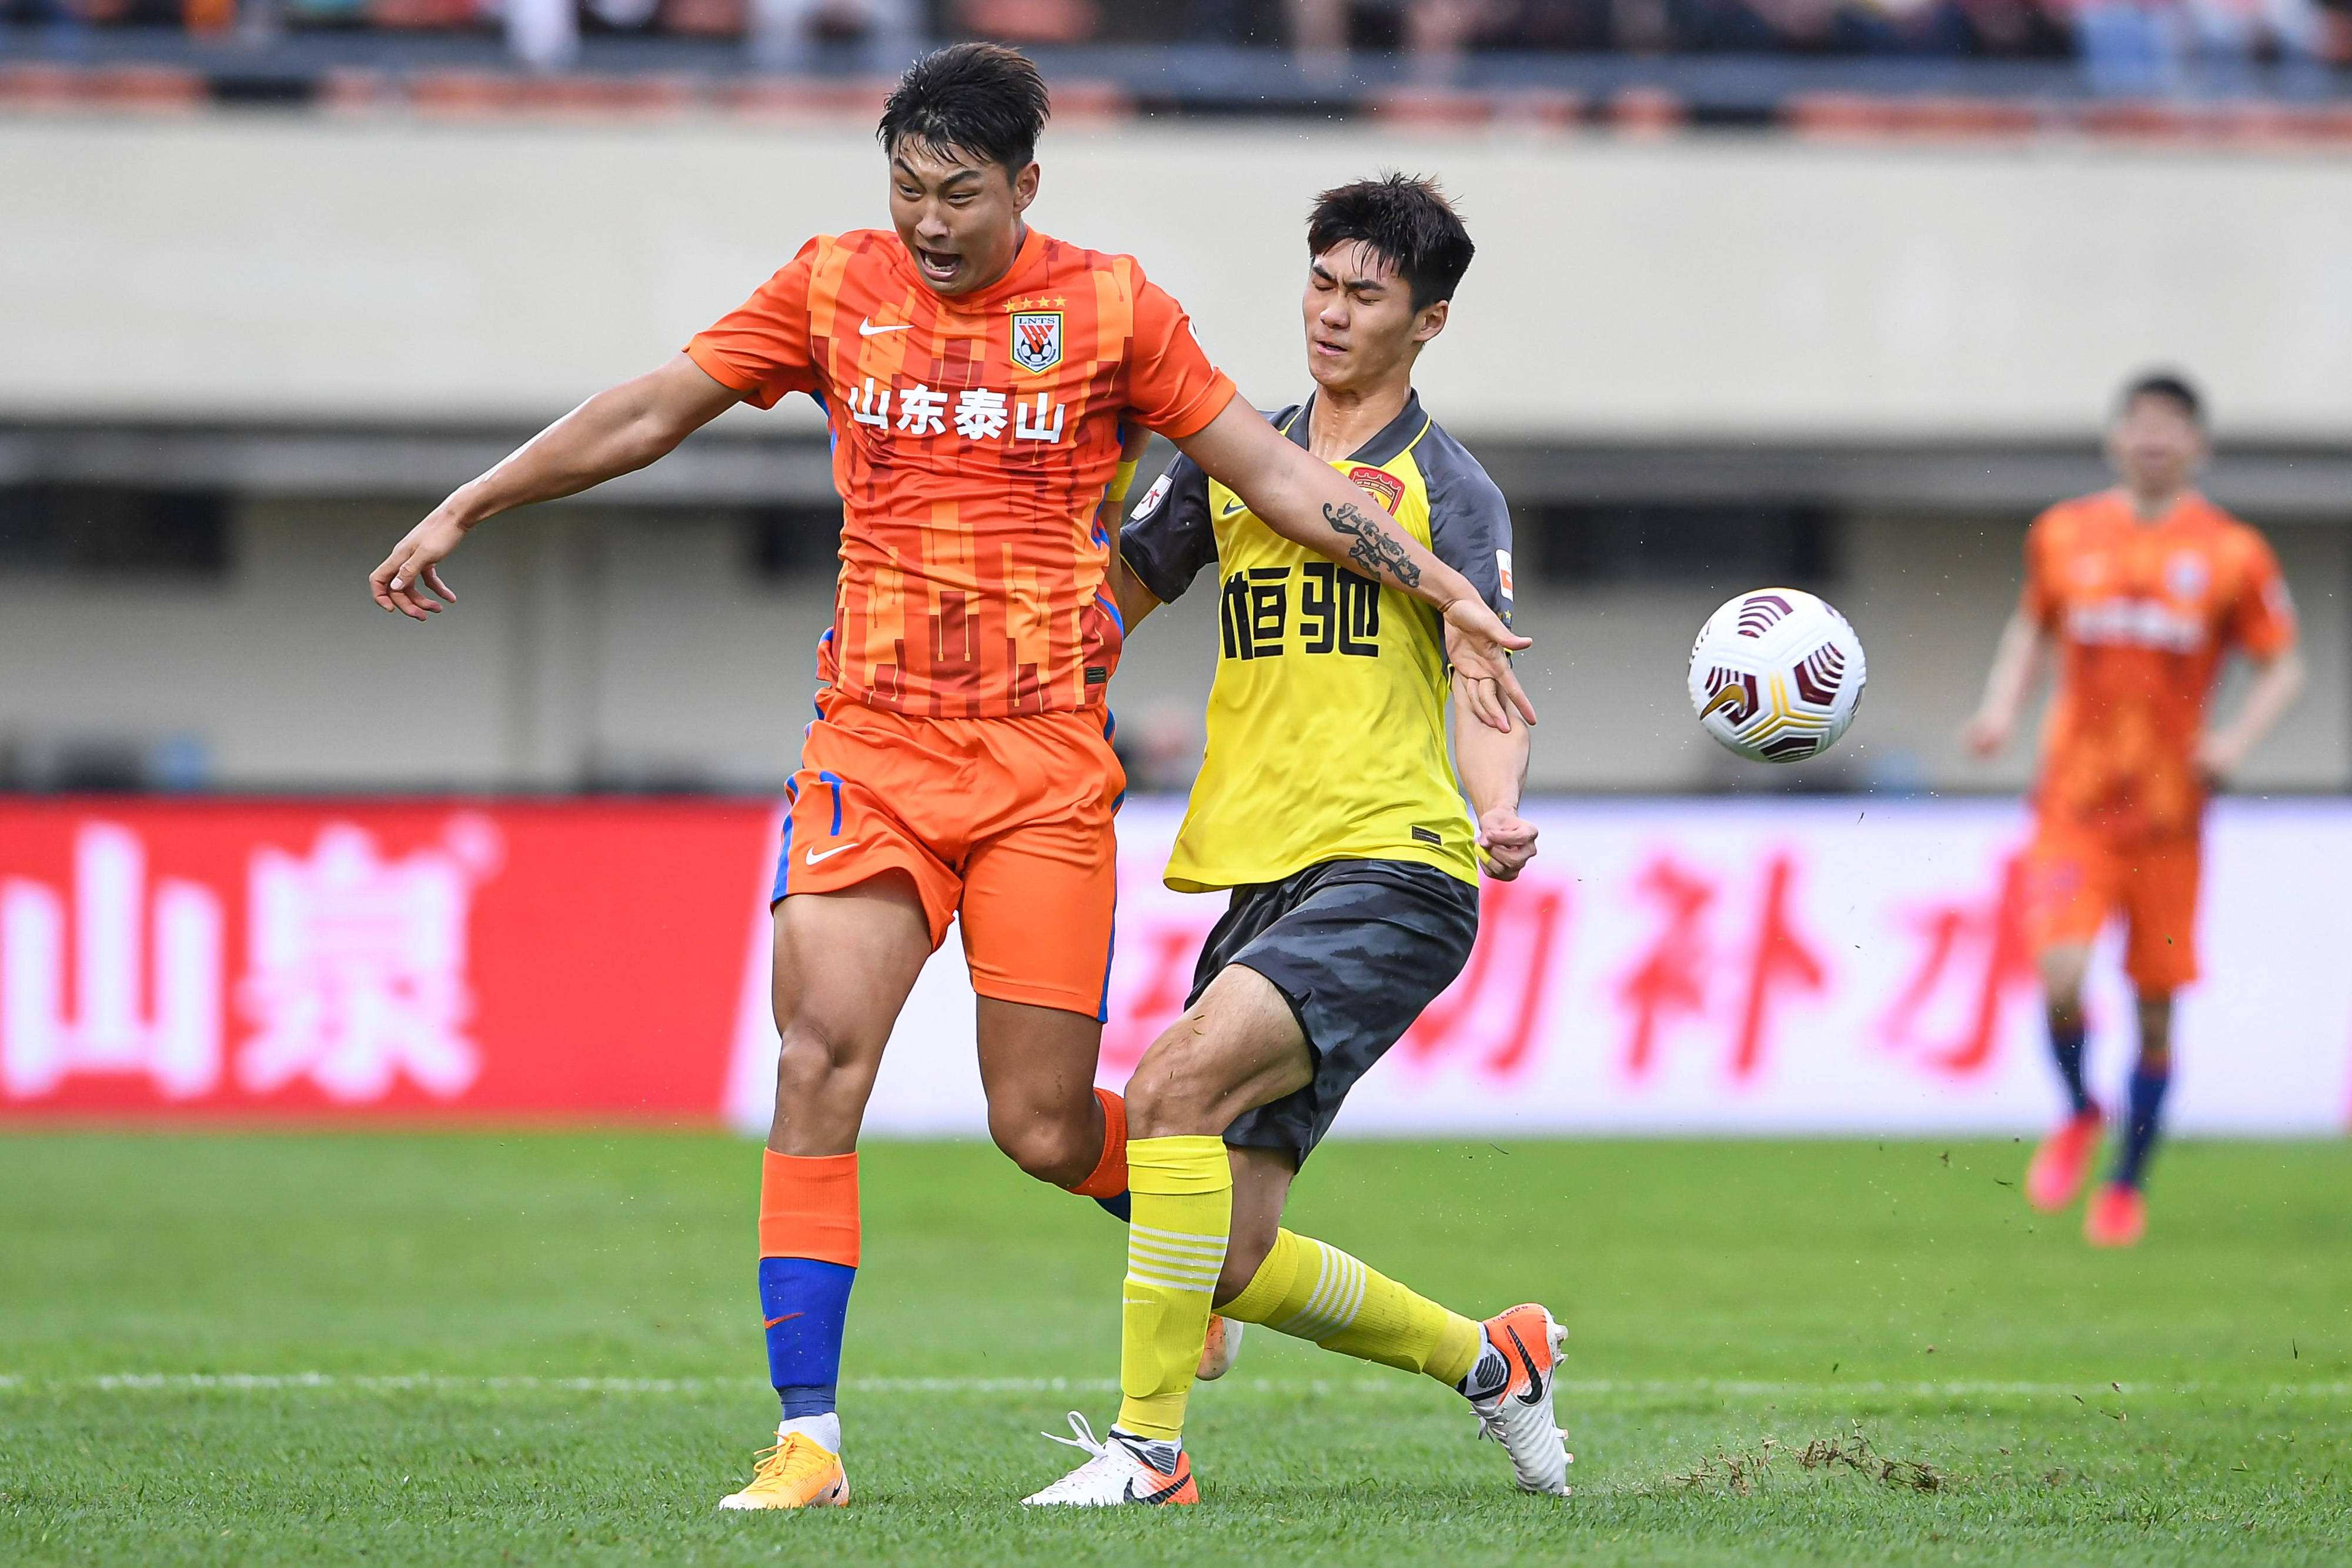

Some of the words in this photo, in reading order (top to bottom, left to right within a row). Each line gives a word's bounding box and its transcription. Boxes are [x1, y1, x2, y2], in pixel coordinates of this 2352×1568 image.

[847, 377, 1065, 444] 山东泰山
[1221, 561, 1381, 660] 恒驰
